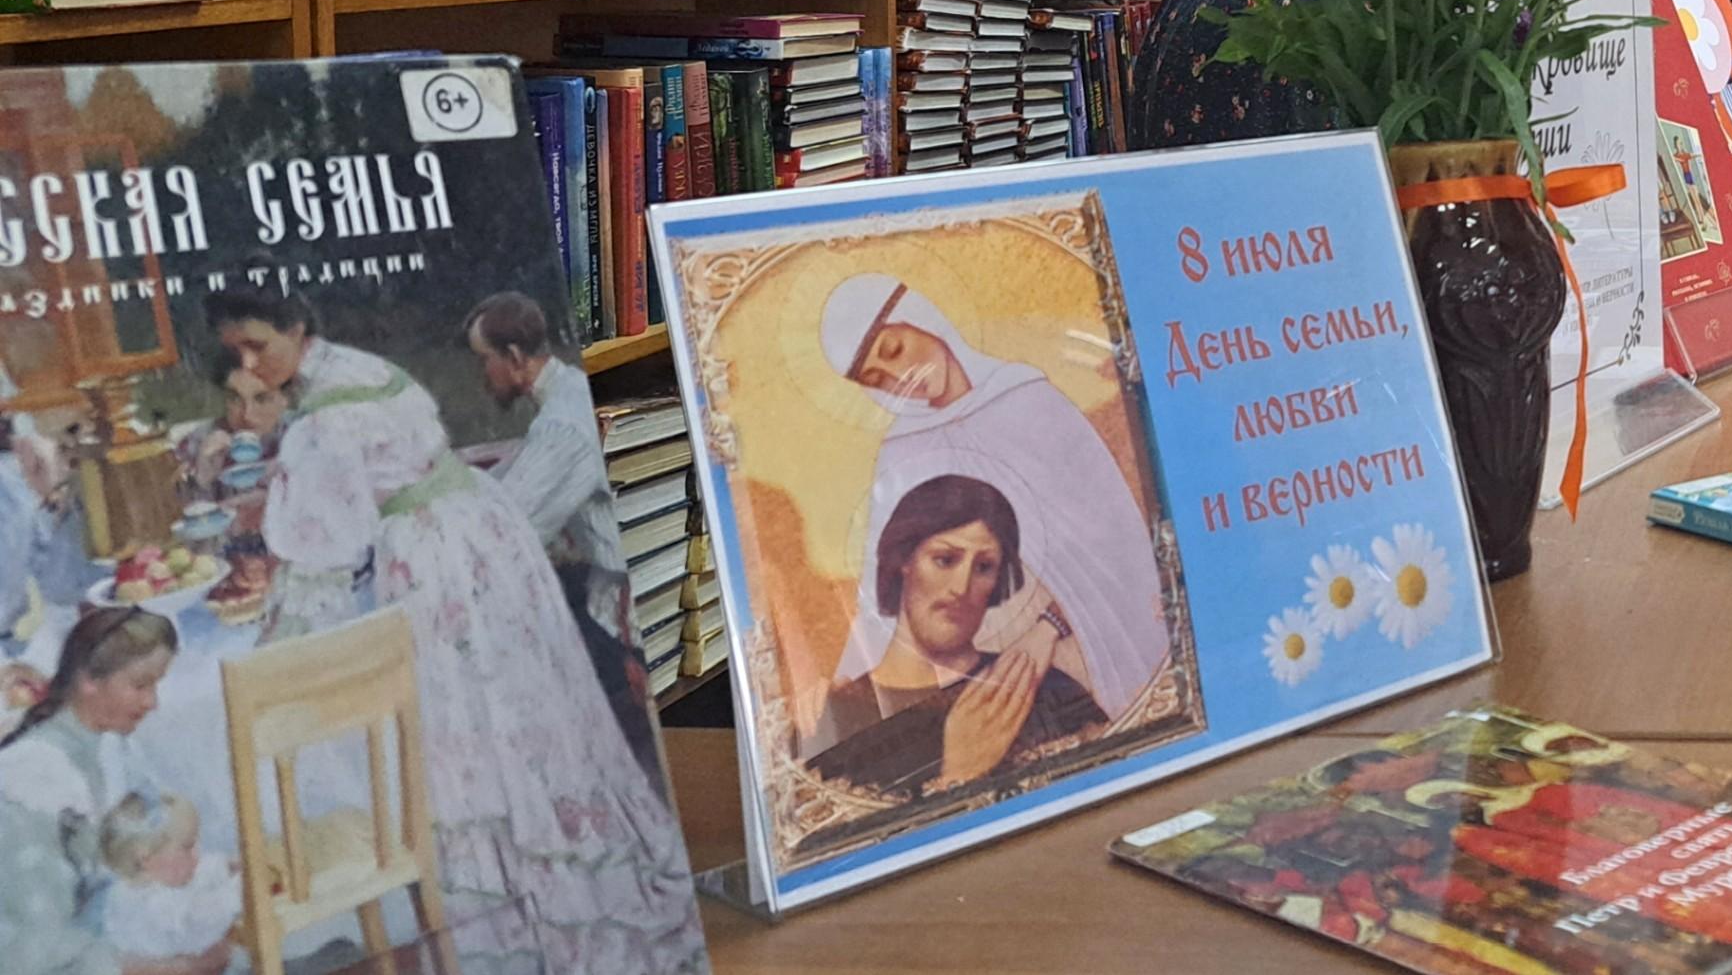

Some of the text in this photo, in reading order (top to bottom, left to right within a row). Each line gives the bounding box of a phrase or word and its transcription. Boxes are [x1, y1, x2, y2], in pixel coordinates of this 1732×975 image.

[436, 86, 471, 116] 6+
[1176, 224, 1334, 284] 8 июля
[1166, 300, 1410, 390] День семьи,
[1233, 380, 1360, 443] любви
[1203, 443, 1426, 533] и верности
[1553, 893, 1643, 936] Петр
